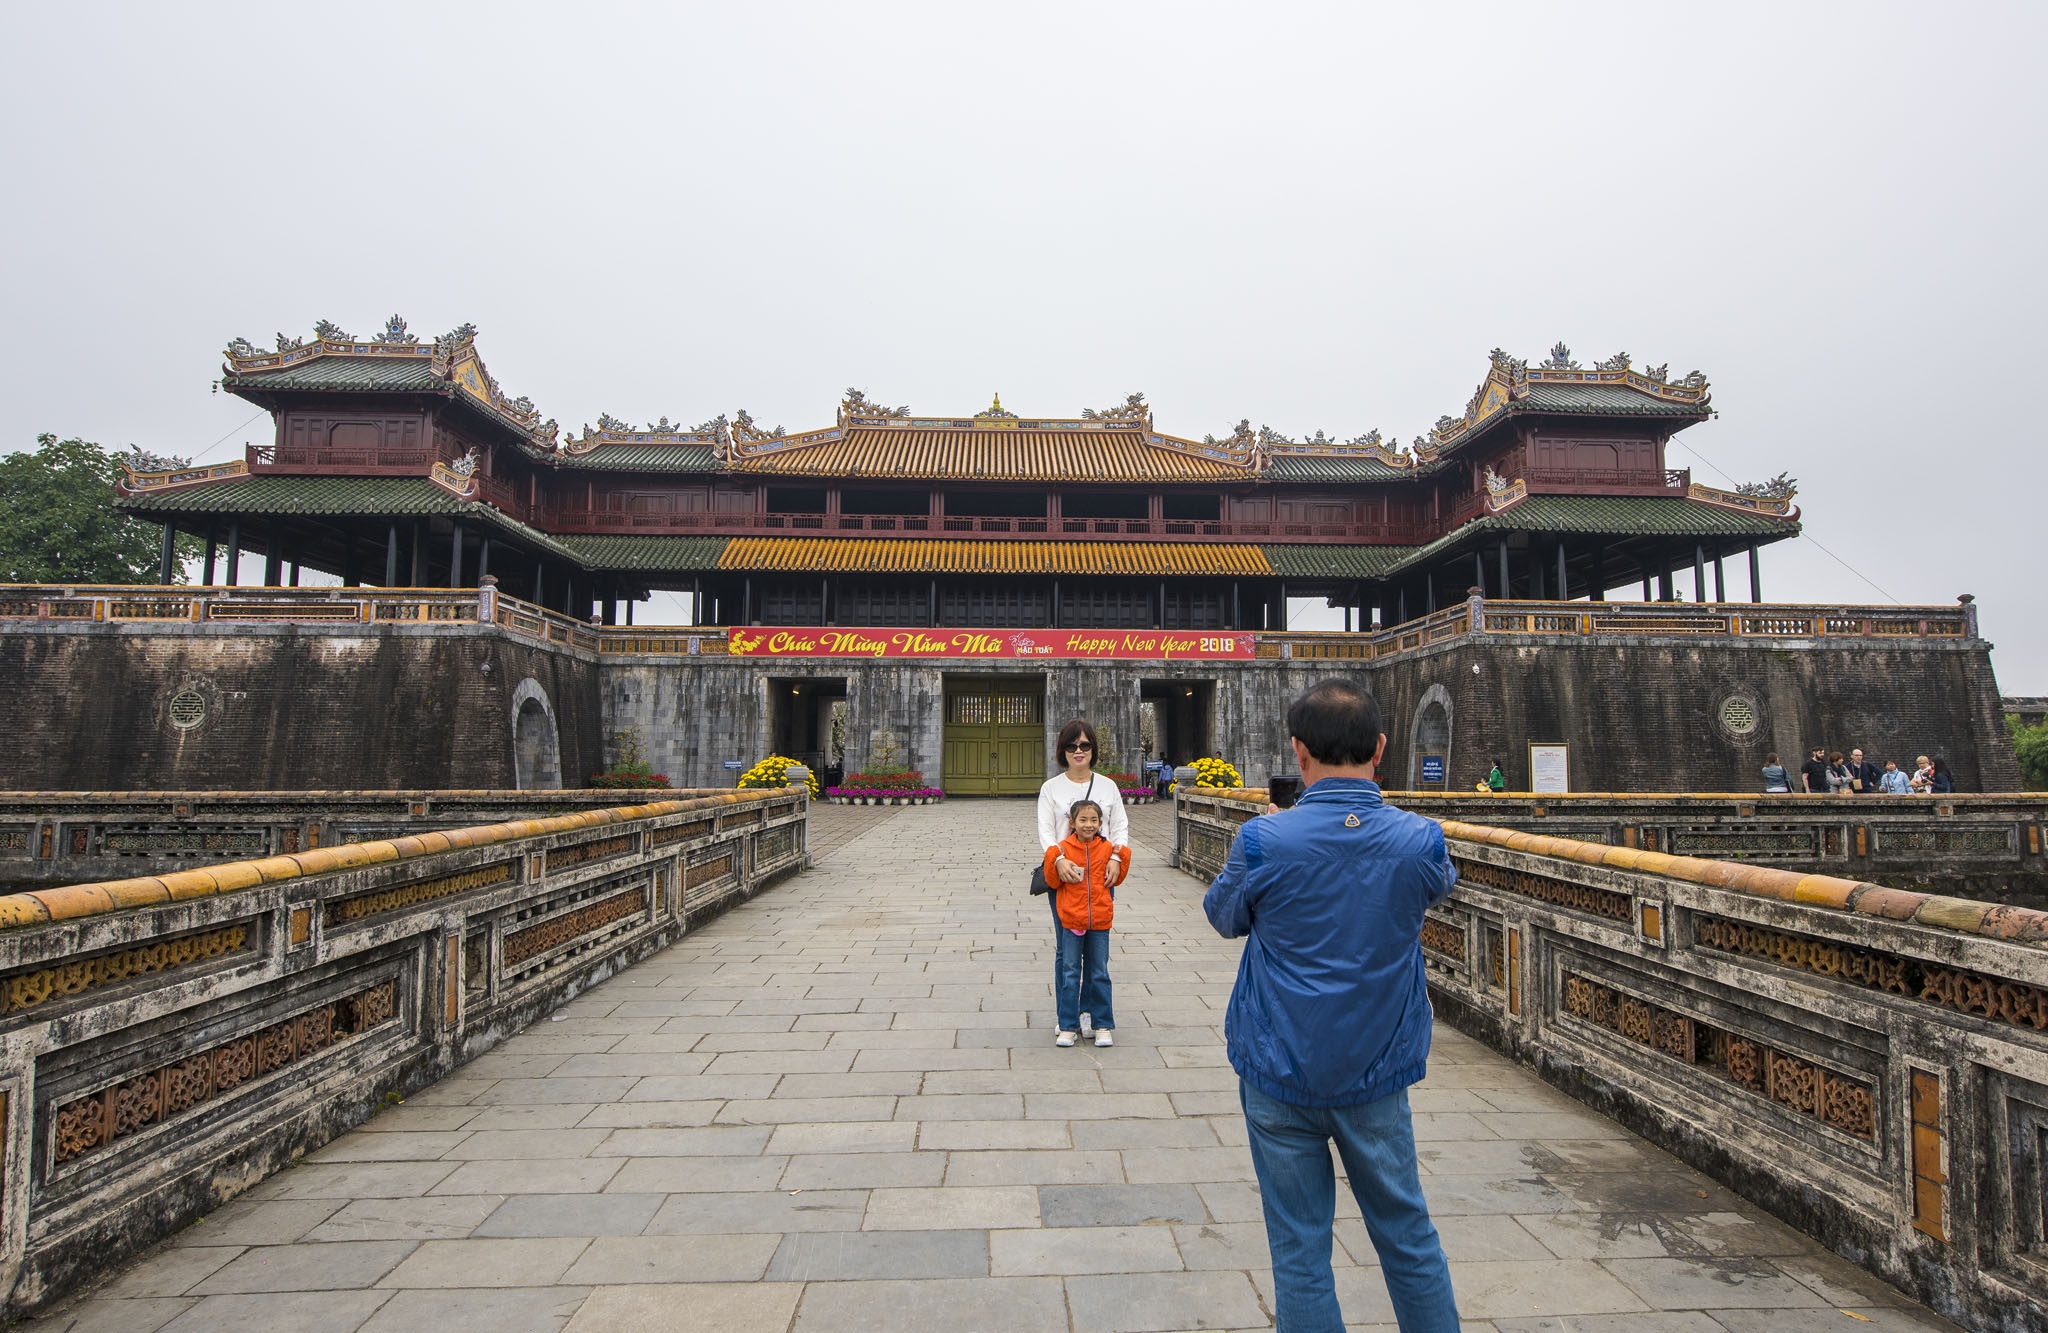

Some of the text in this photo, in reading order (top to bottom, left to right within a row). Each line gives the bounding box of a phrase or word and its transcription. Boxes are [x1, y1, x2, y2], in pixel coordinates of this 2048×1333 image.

[768, 631, 1003, 657] Chúc Mừng Năm Mới
[1066, 634, 1235, 658] Happy New Year 2018
